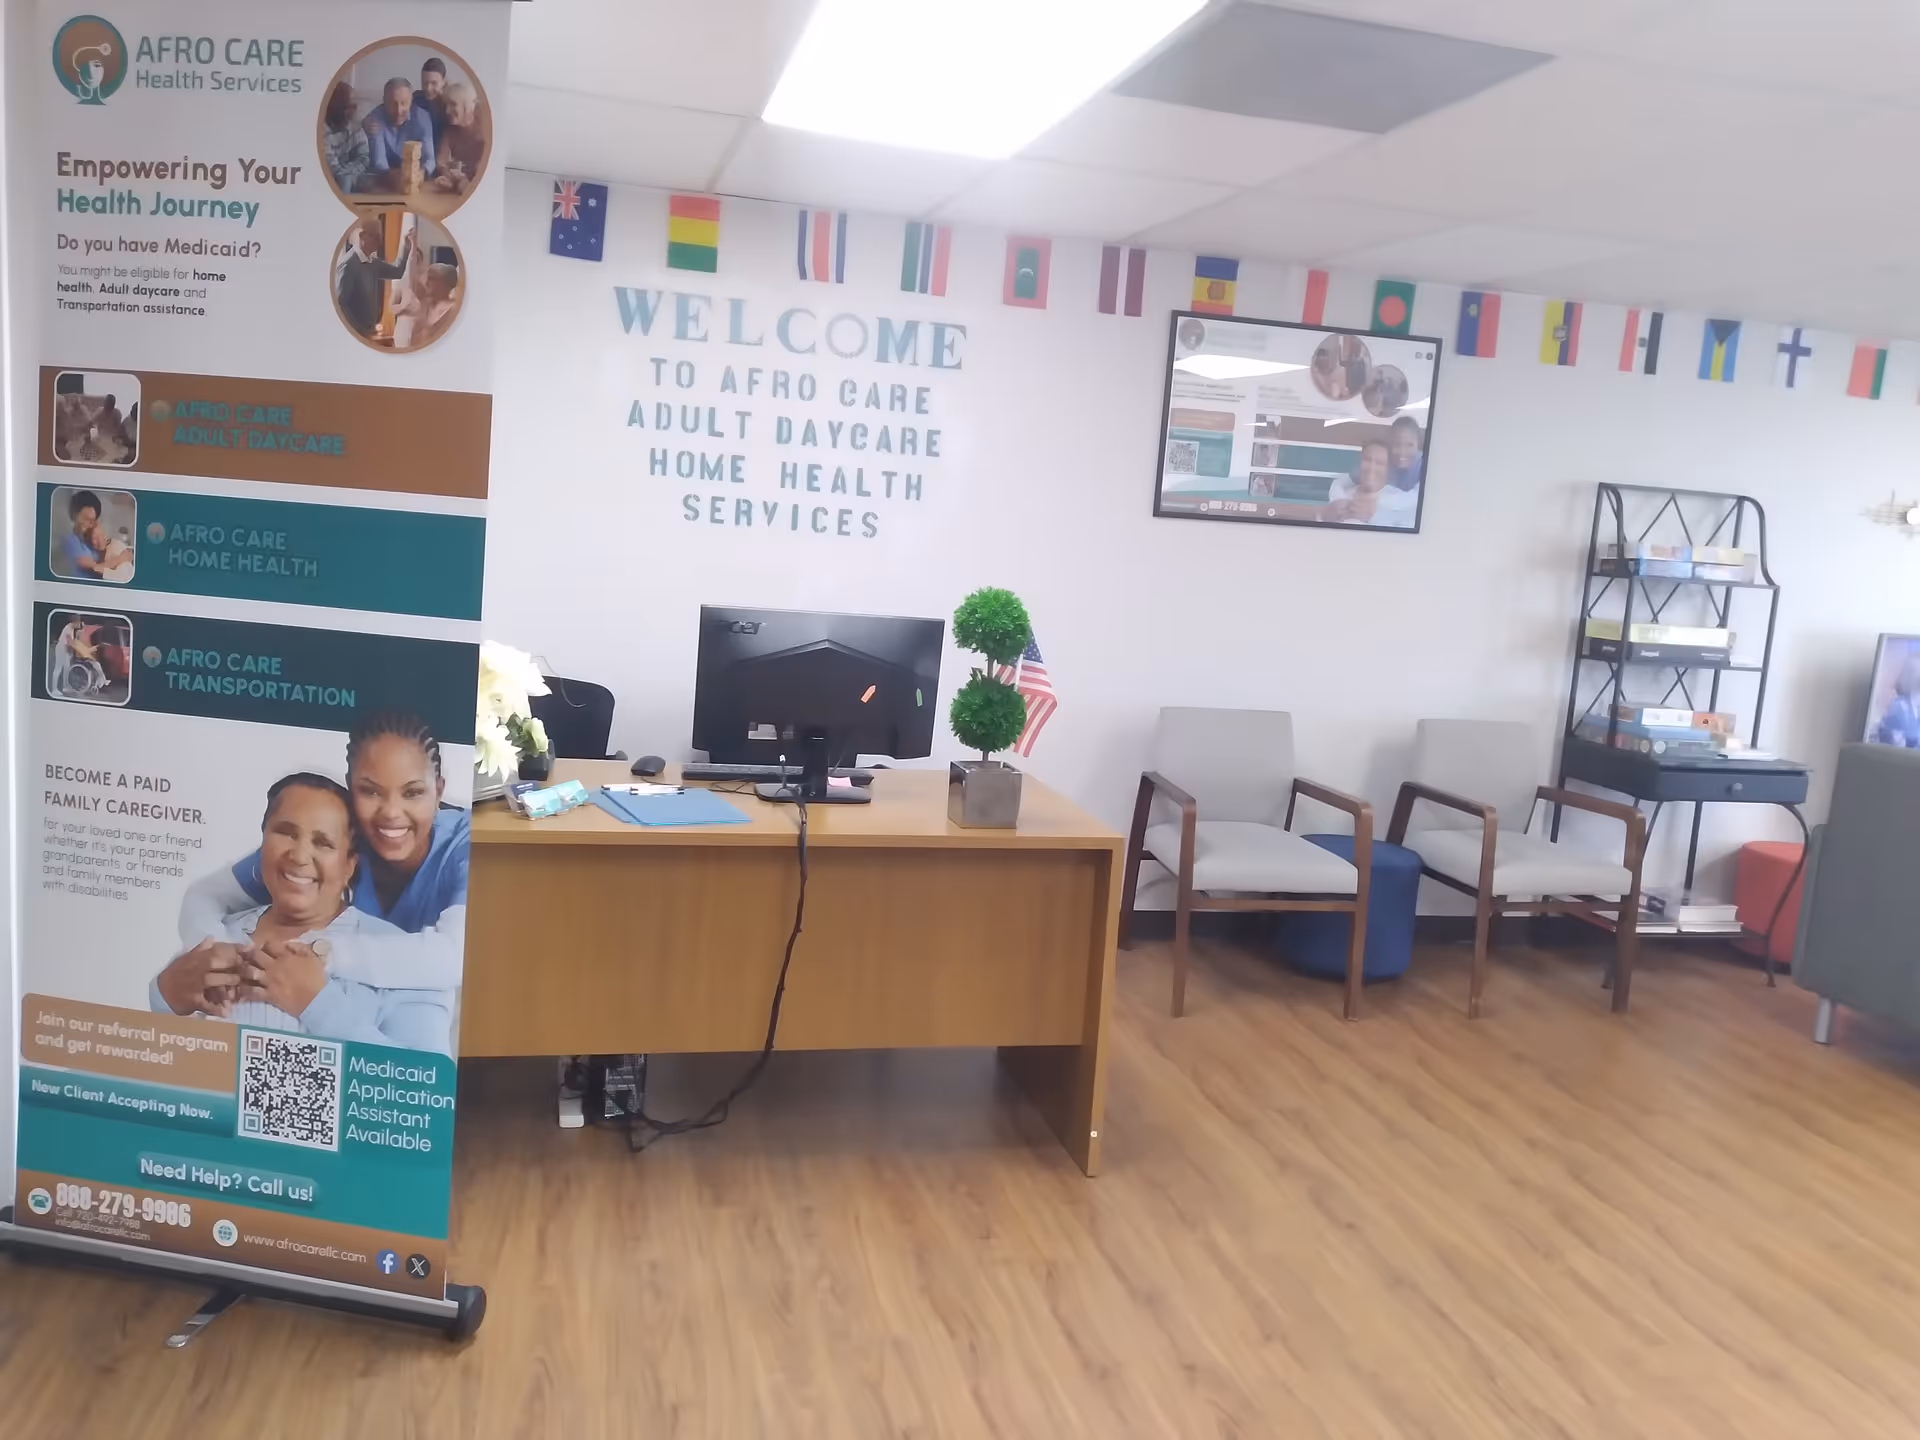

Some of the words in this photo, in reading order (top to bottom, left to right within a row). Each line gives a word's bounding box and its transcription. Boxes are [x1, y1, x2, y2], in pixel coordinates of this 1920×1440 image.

[136, 36, 215, 64] AFRO
[225, 38, 304, 67] CARE
[136, 69, 203, 90] Health
[210, 71, 302, 93] Services
[57, 151, 227, 190] Empowering
[238, 157, 302, 185] Your
[57, 188, 141, 216] Health
[150, 191, 260, 229] Journey
[57, 233, 78, 250] Do
[84, 239, 113, 256] you
[118, 235, 159, 253] have
[165, 238, 262, 258] Medicaid?
[58, 264, 77, 276] You
[80, 265, 111, 280] might
[113, 265, 128, 278] be
[130, 266, 170, 281] eligible
[173, 268, 189, 280] for
[193, 268, 227, 282] home
[99, 283, 130, 295] Adult
[132, 284, 180, 299] daycare
[183, 288, 207, 298] and
[56, 298, 140, 314] Transportation
[143, 304, 208, 317] assistance.
[613, 286, 967, 370] WELCOME
[650, 357, 696, 389] TO
[720, 365, 816, 402] AFRO
[838, 378, 931, 414] CARE
[175, 400, 230, 422] AFRO
[236, 404, 292, 426] CARE
[173, 424, 243, 448] ADULT
[248, 427, 345, 456] DAYCARE
[627, 399, 752, 440] ADULT
[775, 415, 942, 458] DAYCARE
[649, 447, 746, 483] HOME
[780, 461, 923, 501] HEALTH
[682, 493, 879, 539] SERVICES
[170, 523, 225, 545] AFRO
[231, 528, 287, 550] CARE
[168, 548, 231, 570] HOME
[238, 553, 318, 577] HEALTH
[720, 620, 763, 635] cer
[166, 647, 221, 670] AFRO
[227, 652, 282, 675] CARE
[165, 671, 355, 708] TRANSPORTATION
[45, 763, 112, 787] BECOME
[116, 773, 128, 788] A
[134, 775, 171, 793] PAID
[44, 790, 101, 812] FAMILY
[106, 799, 207, 825] CAREGIVER.
[43, 817, 58, 830] for
[62, 822, 86, 835] your
[89, 823, 121, 839] loved
[124, 830, 146, 842] one
[150, 834, 162, 843] or
[166, 833, 202, 849] friend
[43, 835, 88, 849] whether
[110, 844, 135, 856] your
[43, 865, 63, 876] and
[67, 866, 101, 884] family
[104, 873, 161, 890] members
[126, 861, 138, 871] or
[142, 860, 184, 877] friends
[42, 880, 65, 891] with
[68, 882, 128, 901] disabilities
[36, 1010, 65, 1028] Join
[69, 1018, 94, 1033] our
[98, 1021, 154, 1042] referral
[159, 1032, 228, 1053] program
[35, 1033, 63, 1048] and
[67, 1039, 92, 1053] get
[95, 1042, 174, 1066] rewarded!
[349, 1056, 436, 1085] Medicaid
[31, 1079, 61, 1095] New
[64, 1084, 104, 1102] Client
[107, 1091, 176, 1118] Accepting
[179, 1102, 214, 1120] Now.
[347, 1078, 455, 1111] Application
[346, 1101, 431, 1129] Assistant
[345, 1123, 432, 1152] Available
[140, 1157, 187, 1181] Need
[191, 1165, 242, 1191] Help?
[247, 1175, 283, 1196] Call
[288, 1185, 313, 1202] us!
